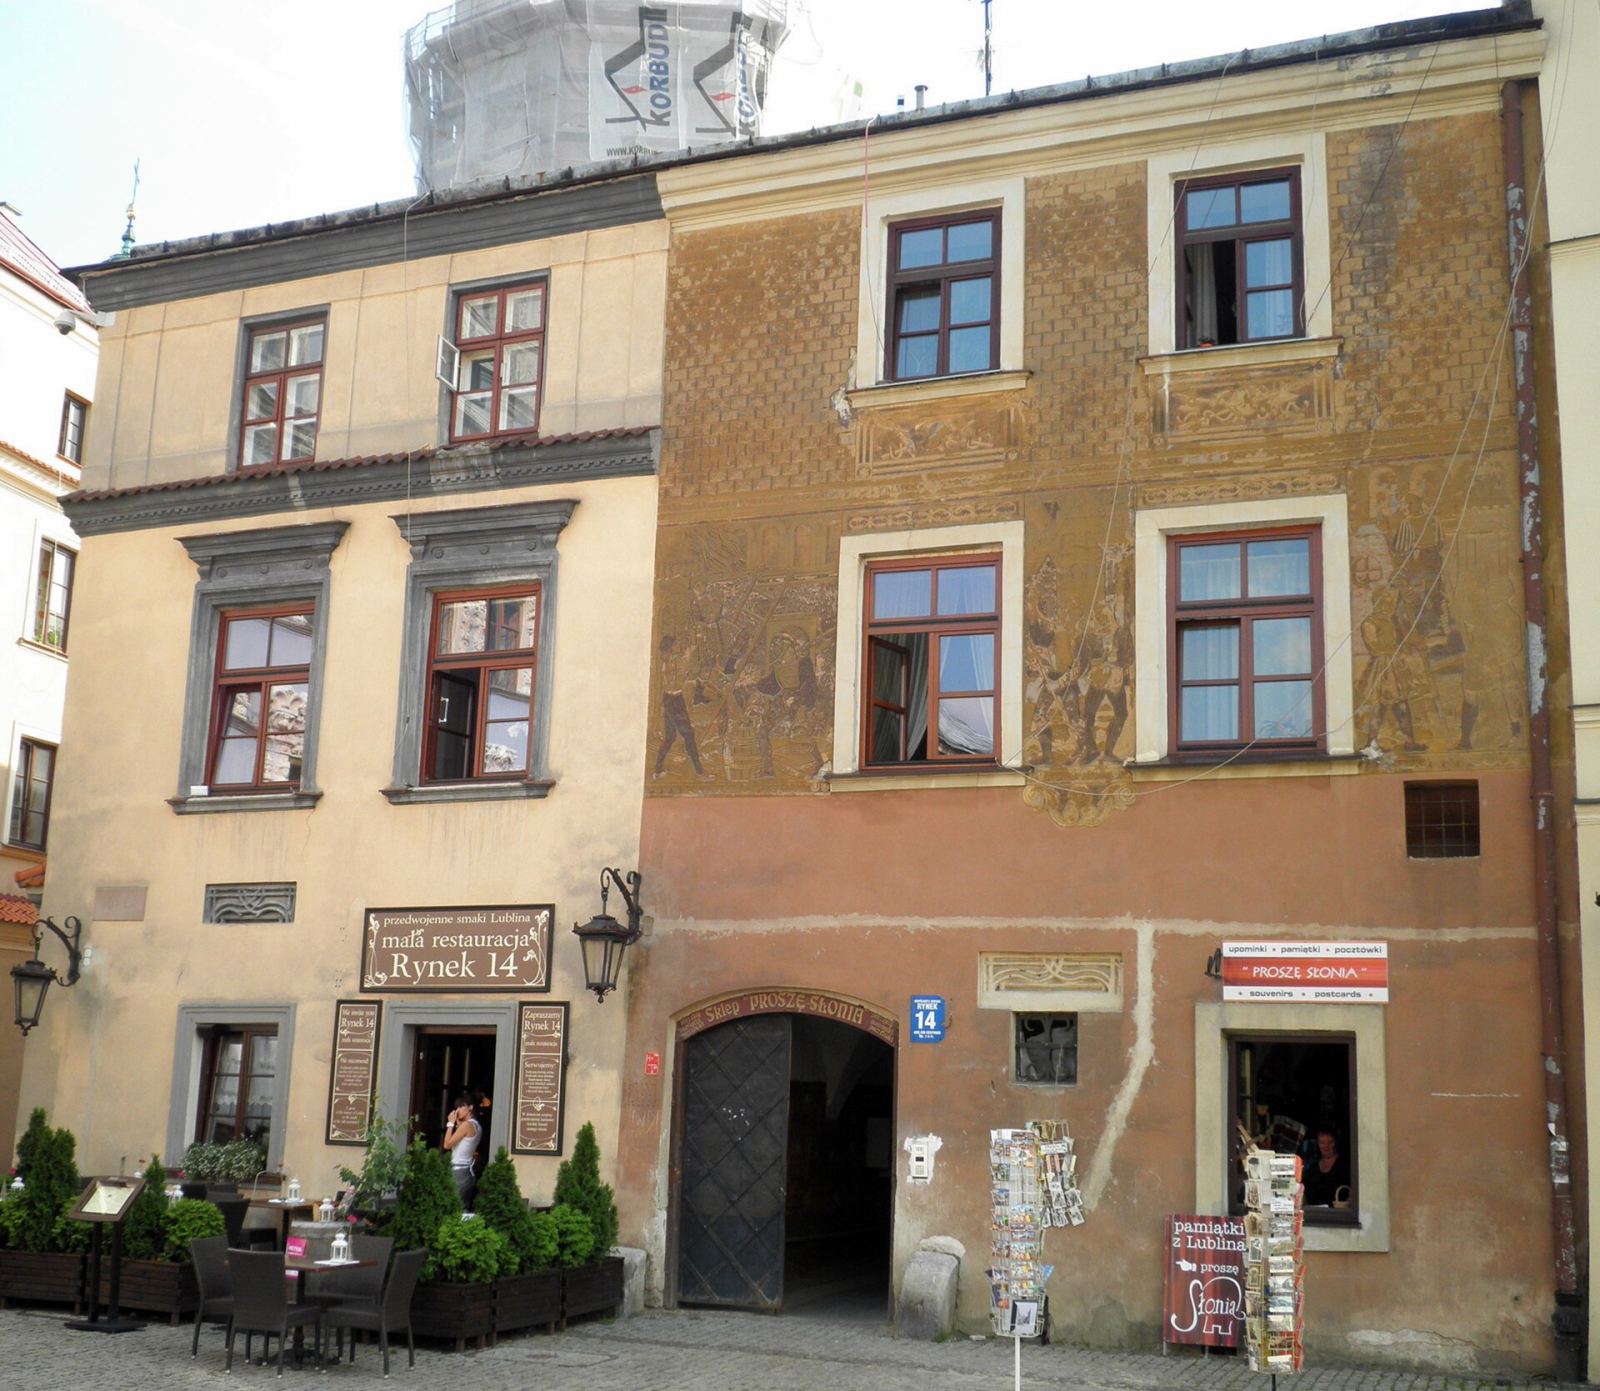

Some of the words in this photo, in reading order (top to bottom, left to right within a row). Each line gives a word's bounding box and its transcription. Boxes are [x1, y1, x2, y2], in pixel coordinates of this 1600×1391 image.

[383, 913, 453, 927] przedwojenne
[456, 913, 486, 924] smaki
[491, 912, 531, 923] Lublina
[382, 929, 424, 948] mała
[432, 929, 530, 951] restauracja
[1228, 945, 1267, 953] upominki
[1281, 945, 1321, 954] pamiątki
[1334, 945, 1382, 954] pocztówki
[390, 952, 476, 985] Rynek
[487, 952, 518, 977] 14
[1253, 966, 1301, 979] PROSZĘ
[1306, 966, 1358, 978] SŁONIA
[1314, 990, 1362, 998] postcards
[705, 1001, 740, 1022] Sklep
[917, 1002, 938, 1010] RYNEK
[341, 1017, 363, 1029] Rynek
[366, 1017, 374, 1028] 14
[524, 1020, 549, 1032] Rynek
[552, 1020, 561, 1030] 14
[915, 1011, 936, 1029] 14
[1174, 1221, 1245, 1237] pamiątki
[1172, 1237, 1181, 1248] z
[1187, 1235, 1247, 1251] Lublina
[1200, 1263, 1239, 1275] proszę
[1171, 1279, 1246, 1332] Słonia
